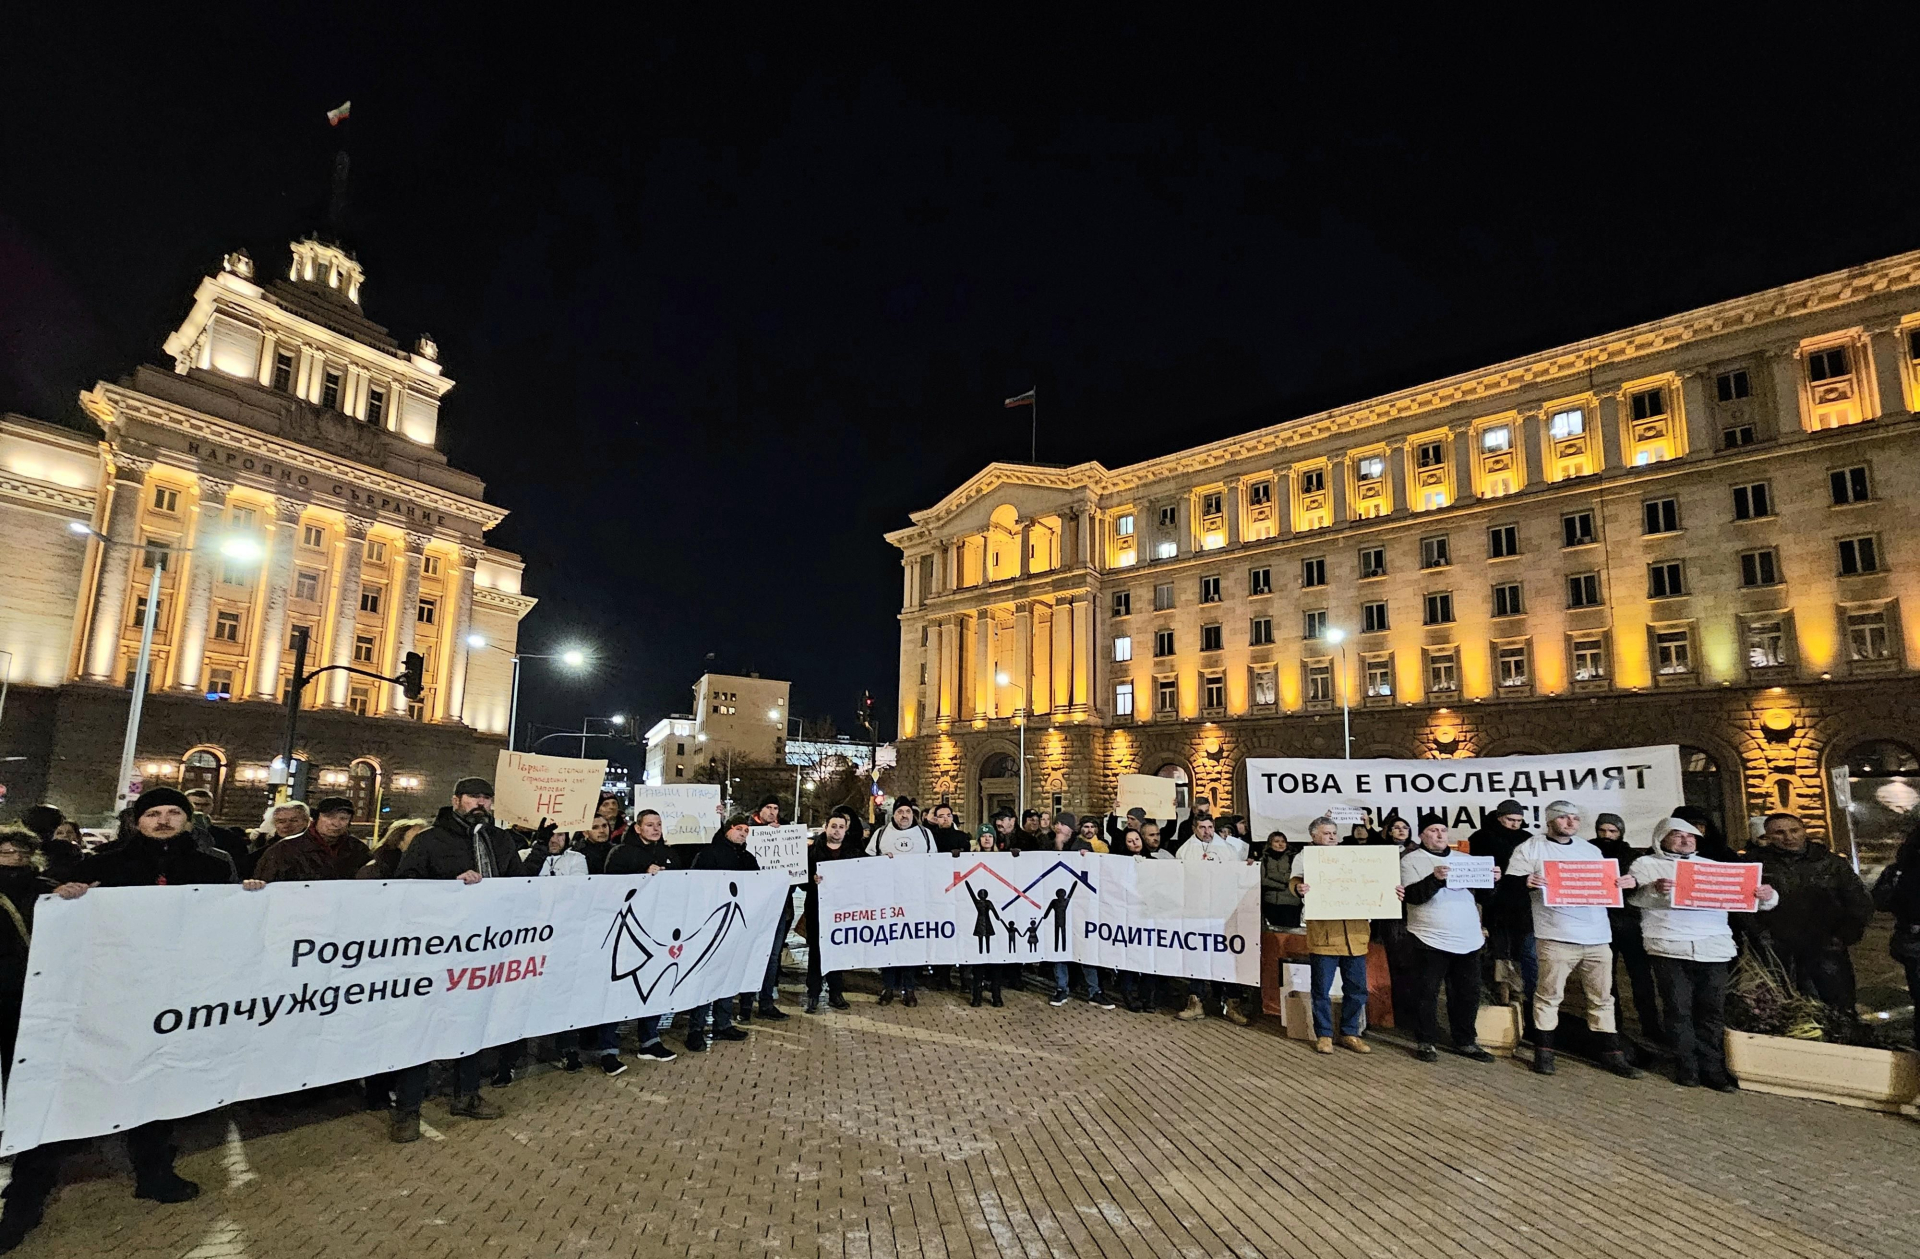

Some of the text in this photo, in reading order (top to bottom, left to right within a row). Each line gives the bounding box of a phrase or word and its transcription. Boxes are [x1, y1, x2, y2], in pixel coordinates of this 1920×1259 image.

[187, 441, 447, 526] НАРОДНО СЪБРАНИЕ
[638, 787, 719, 800] РАВНИ ПРАВА
[1261, 765, 1652, 798] ТОВА Е ПОСЛЕДНИЯТ
[536, 793, 565, 814] НЕ
[754, 842, 800, 857] КРАЙ!
[834, 907, 905, 923] ВРЕМЕ Е ЗА
[292, 924, 554, 969] Родителското
[830, 920, 1246, 955] СПОДЕЛЕНО РОДИТЕЛСТВО
[153, 955, 547, 1035] отчуждение УБИВА!
